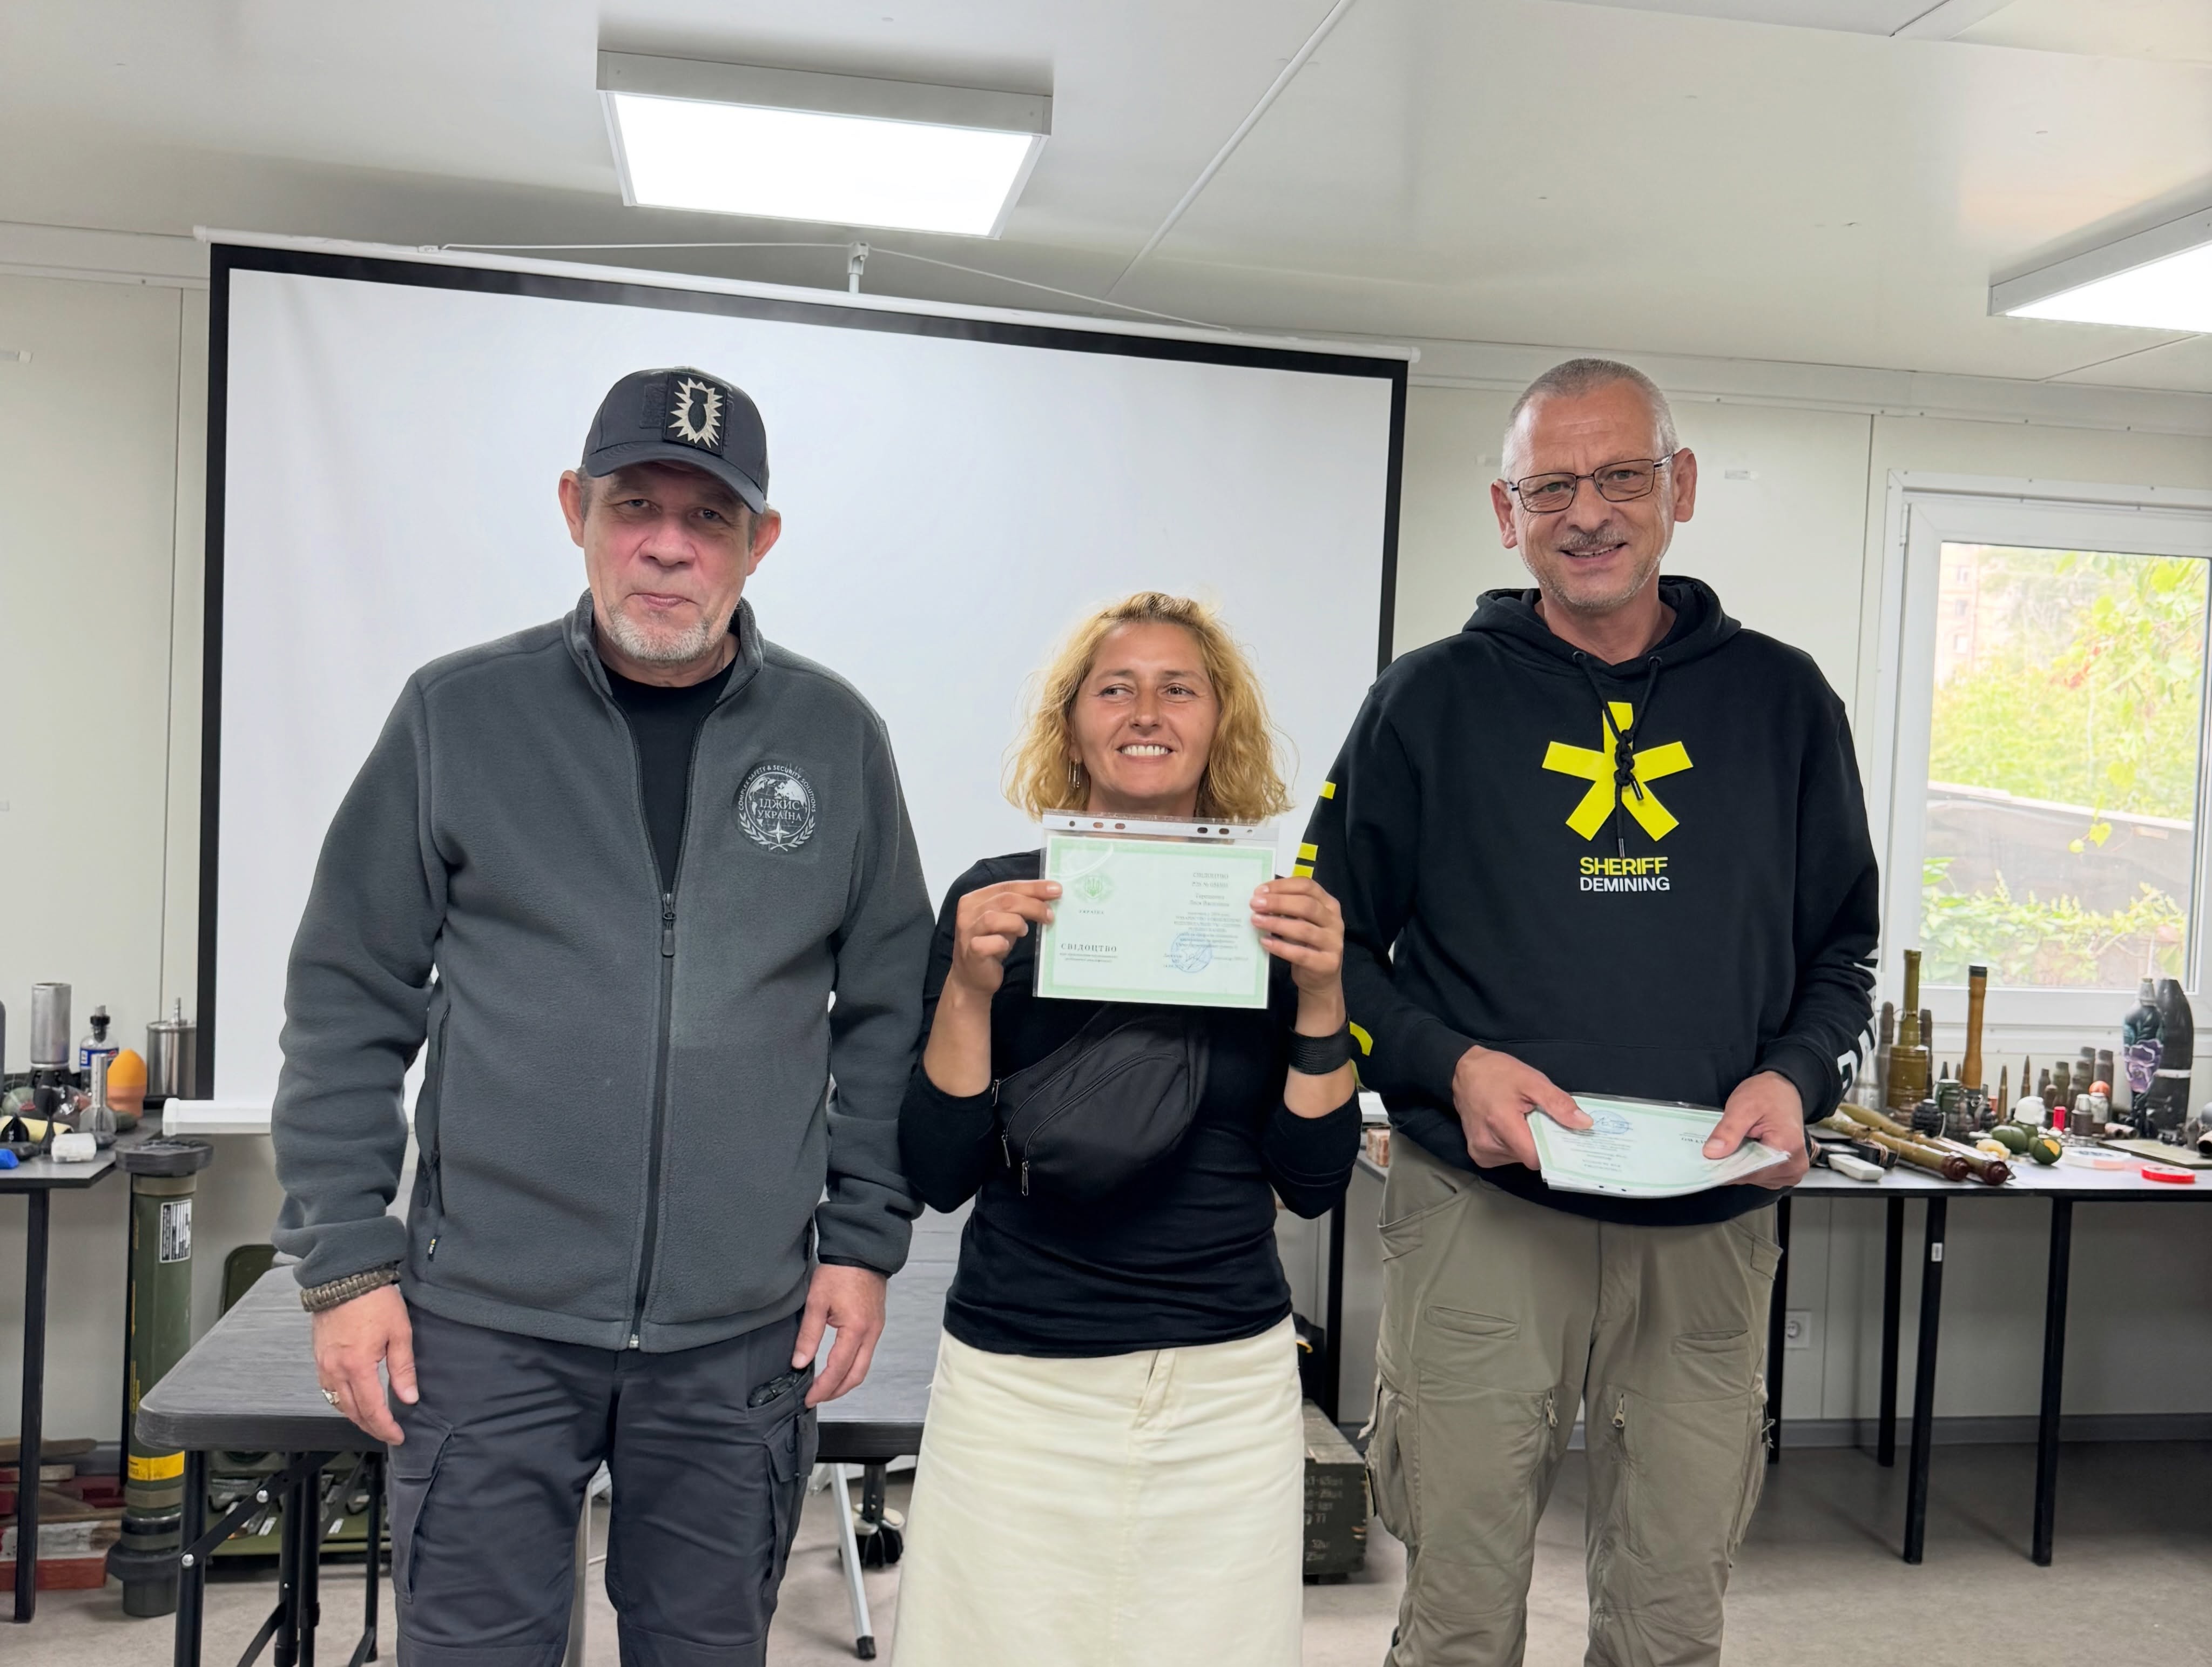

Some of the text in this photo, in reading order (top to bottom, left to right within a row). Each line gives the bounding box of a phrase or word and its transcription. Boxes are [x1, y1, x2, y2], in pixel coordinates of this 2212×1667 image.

[738, 781, 750, 811] COMPLEX
[747, 765, 766, 782] SAFETY
[773, 764, 801, 779] SECURITY
[800, 778, 817, 813] SOLUTIONS
[759, 798, 800, 811] ІДЖИС
[757, 809, 802, 822] УКРАЇНА
[1580, 857, 1668, 875] SHERIFF
[1580, 876, 1670, 892] DEMINING
[1061, 943, 1117, 953] СВІДОЦТВО
